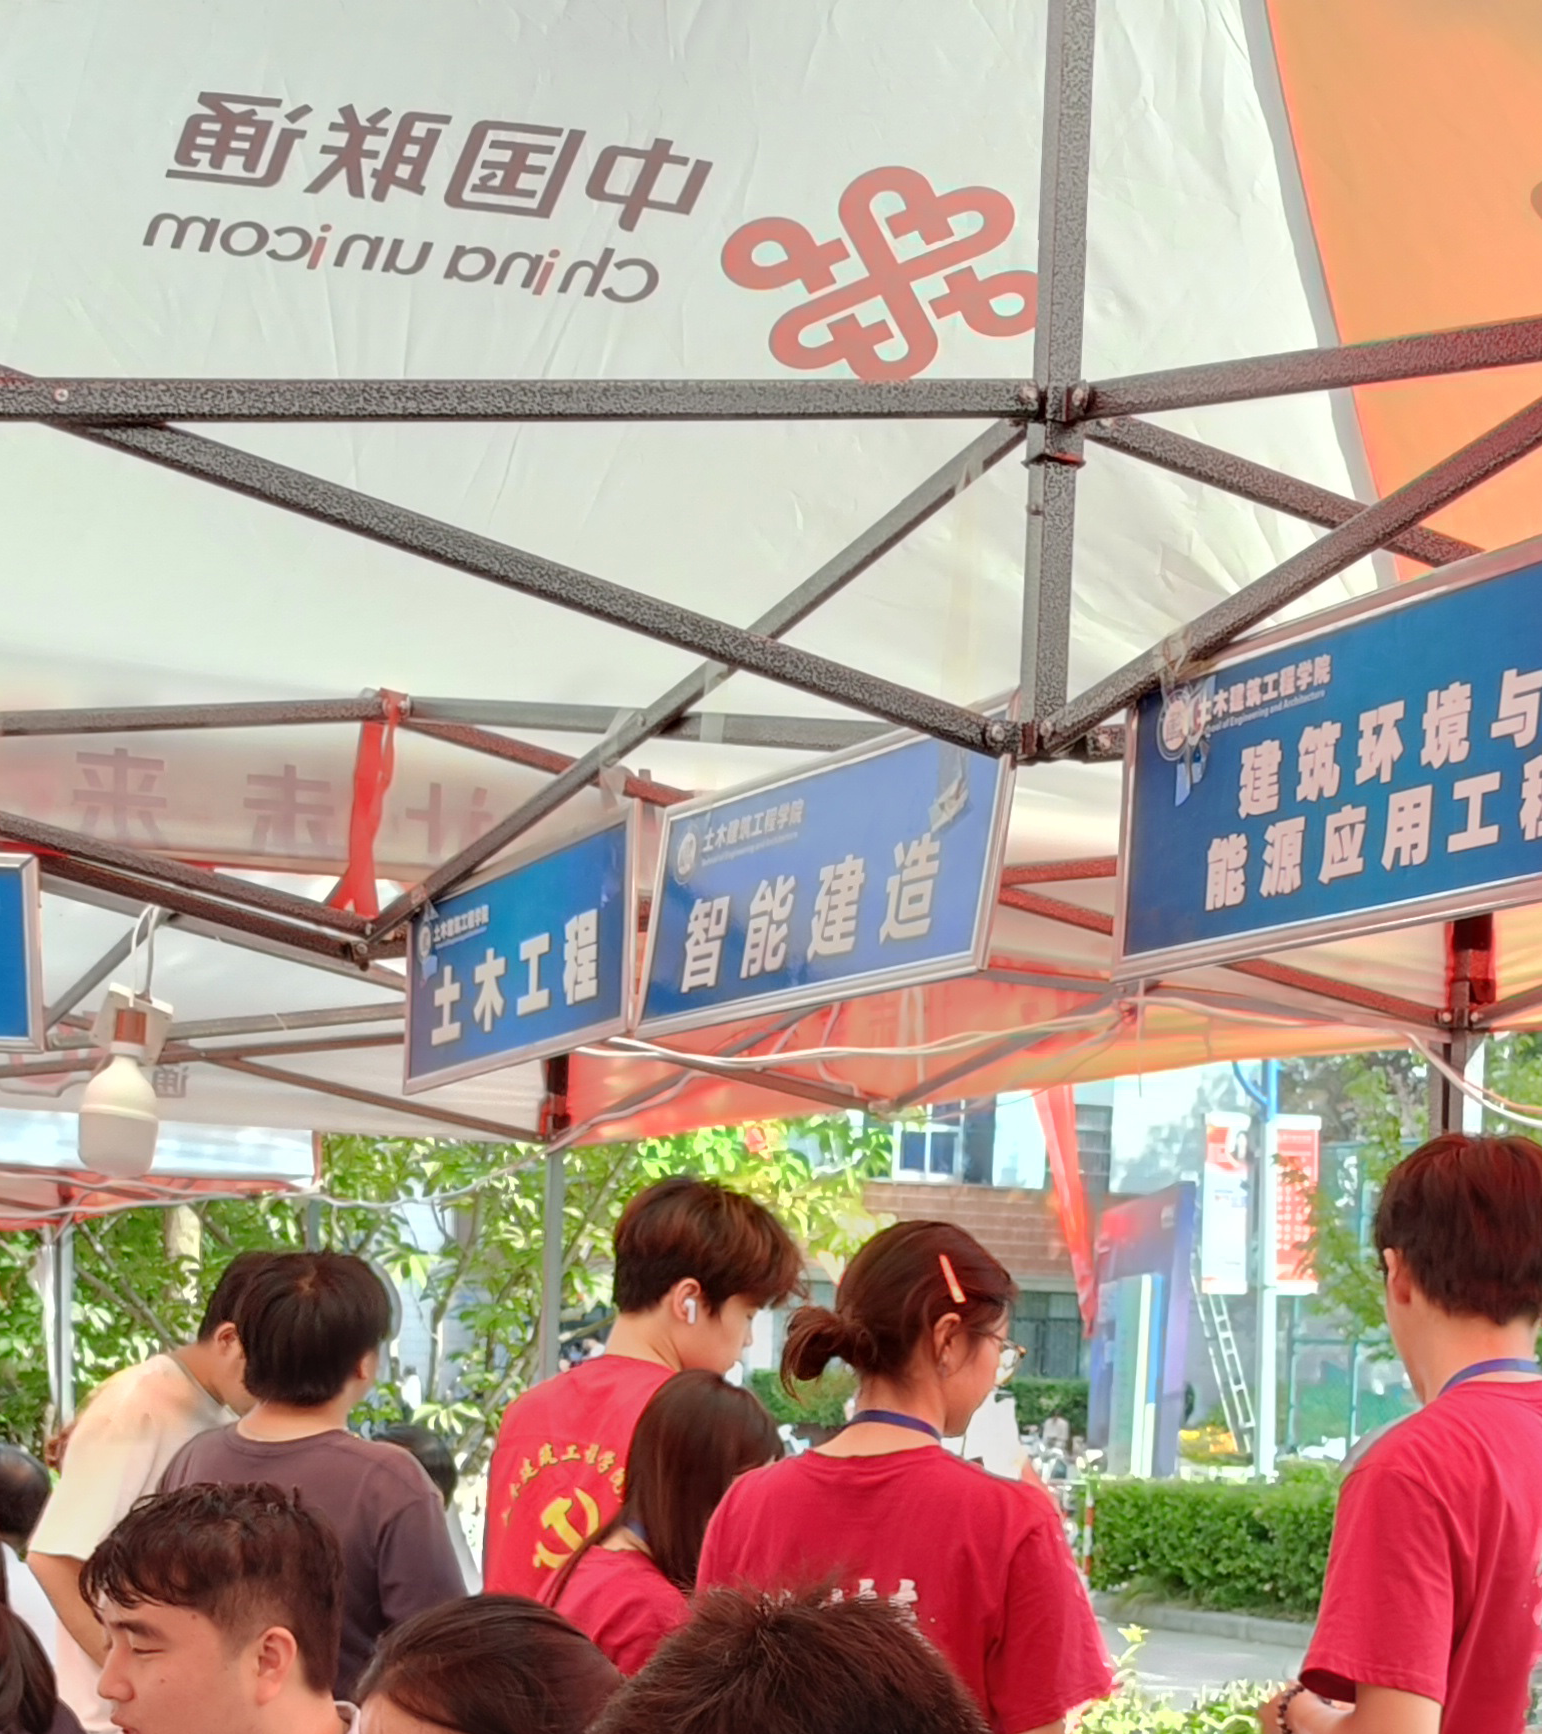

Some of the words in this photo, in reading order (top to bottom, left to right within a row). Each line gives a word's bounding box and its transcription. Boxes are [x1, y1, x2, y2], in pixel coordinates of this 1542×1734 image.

[1199, 653, 1332, 723] 土木建筑工程学院
[702, 798, 804, 853] 土木建筑工程学院
[680, 833, 940, 993] 智能建造
[431, 909, 599, 1046] 土木工程
